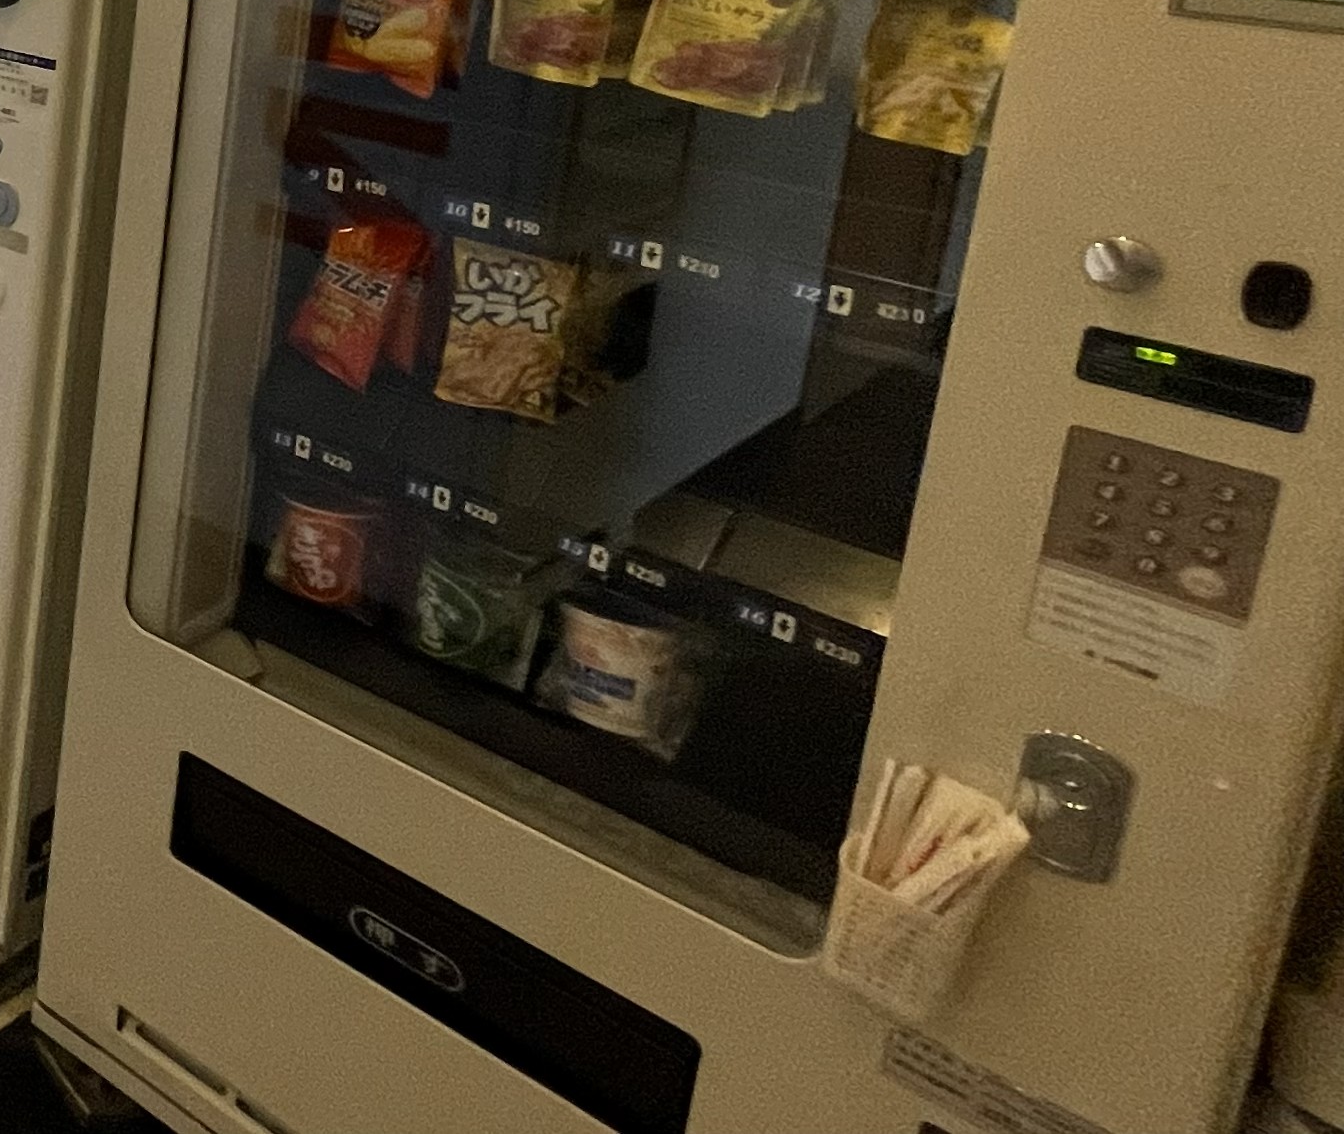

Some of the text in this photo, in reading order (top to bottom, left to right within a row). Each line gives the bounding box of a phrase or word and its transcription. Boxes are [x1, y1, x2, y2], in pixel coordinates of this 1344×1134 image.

[612, 241, 636, 259] 11
[466, 258, 541, 294] いか
[794, 282, 823, 302] 12
[452, 290, 560, 334] フライ
